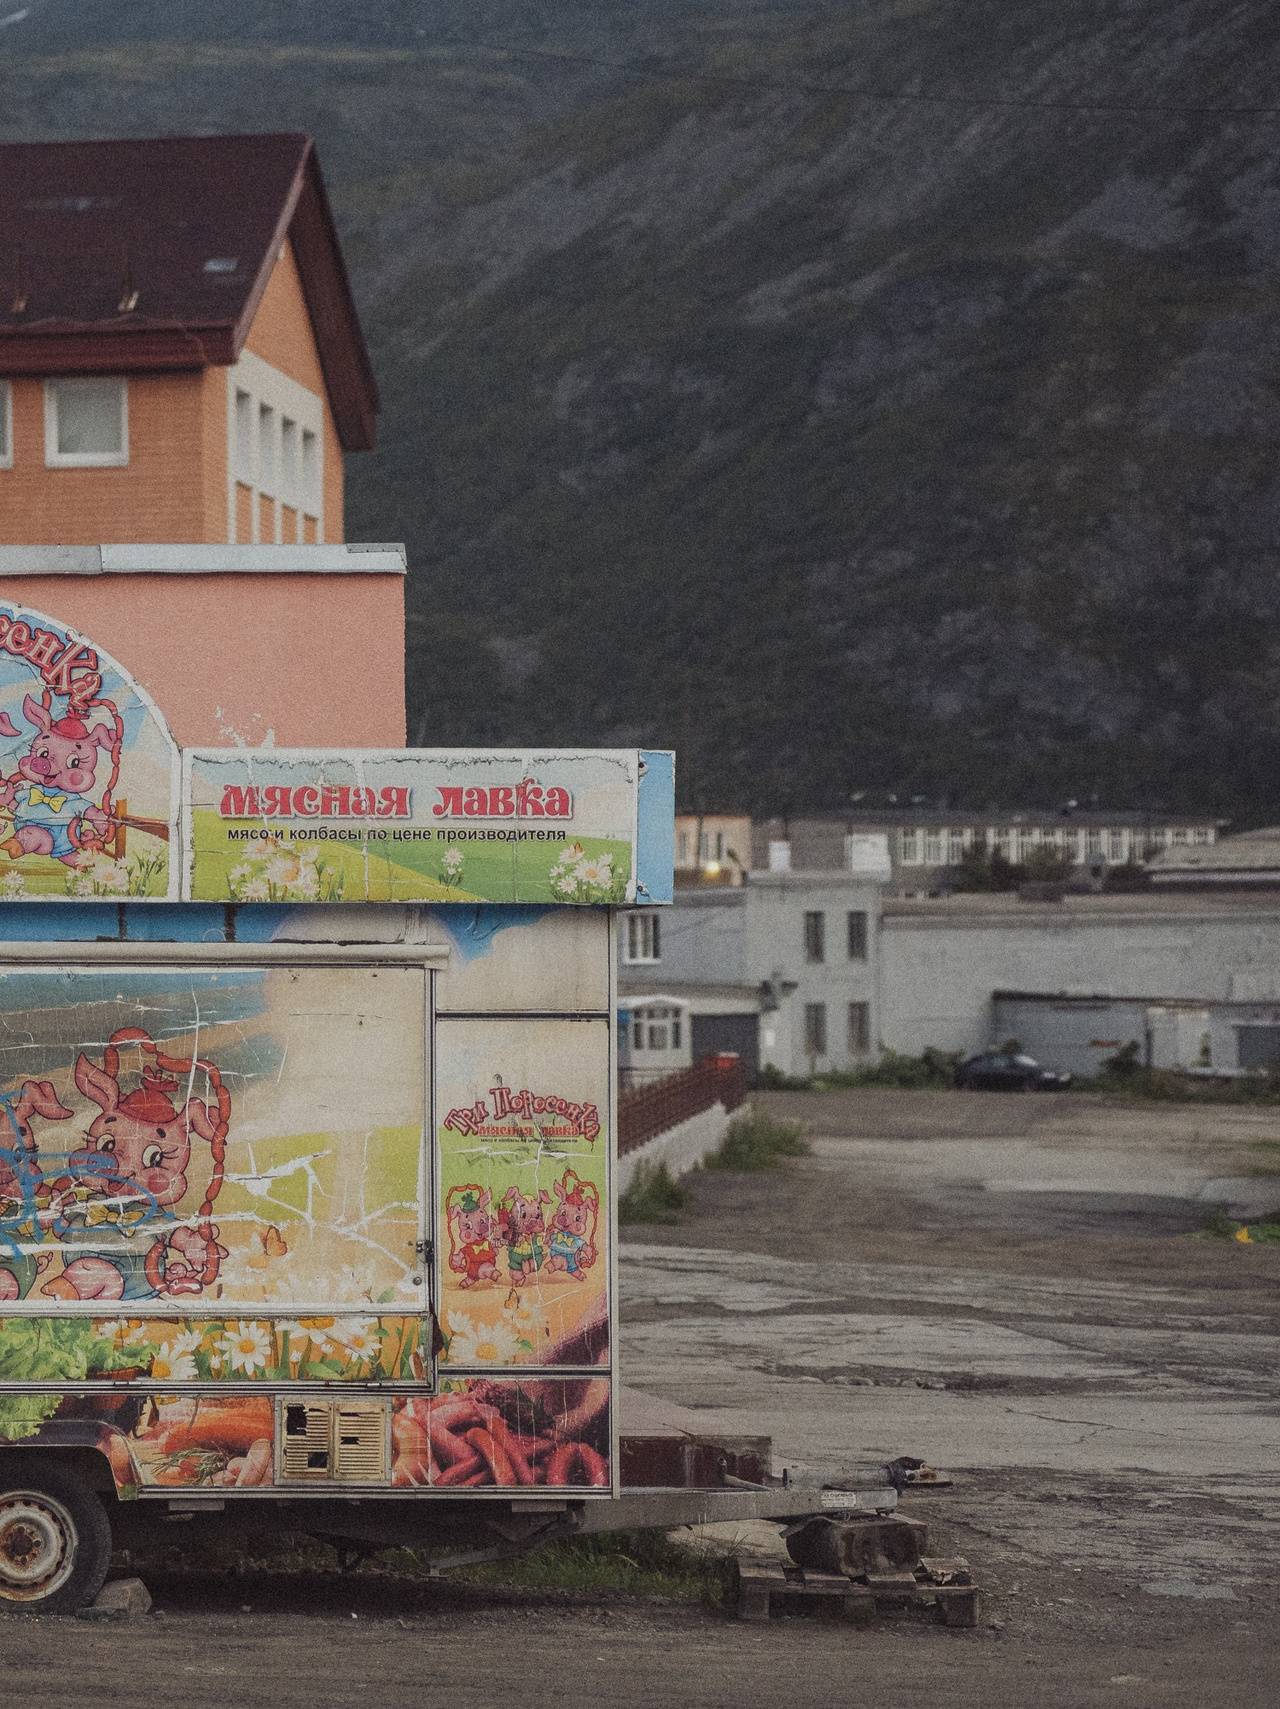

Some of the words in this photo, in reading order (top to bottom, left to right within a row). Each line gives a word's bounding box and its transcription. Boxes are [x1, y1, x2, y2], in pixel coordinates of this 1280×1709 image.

[220, 784, 410, 816] мясная
[432, 777, 571, 816] лавка
[227, 829, 270, 840] мясо
[274, 829, 284, 840] и
[289, 826, 362, 840] колбасы
[367, 829, 388, 840] по
[392, 829, 432, 843] цене
[436, 829, 567, 843] производителя
[443, 1101, 490, 1137] Три
